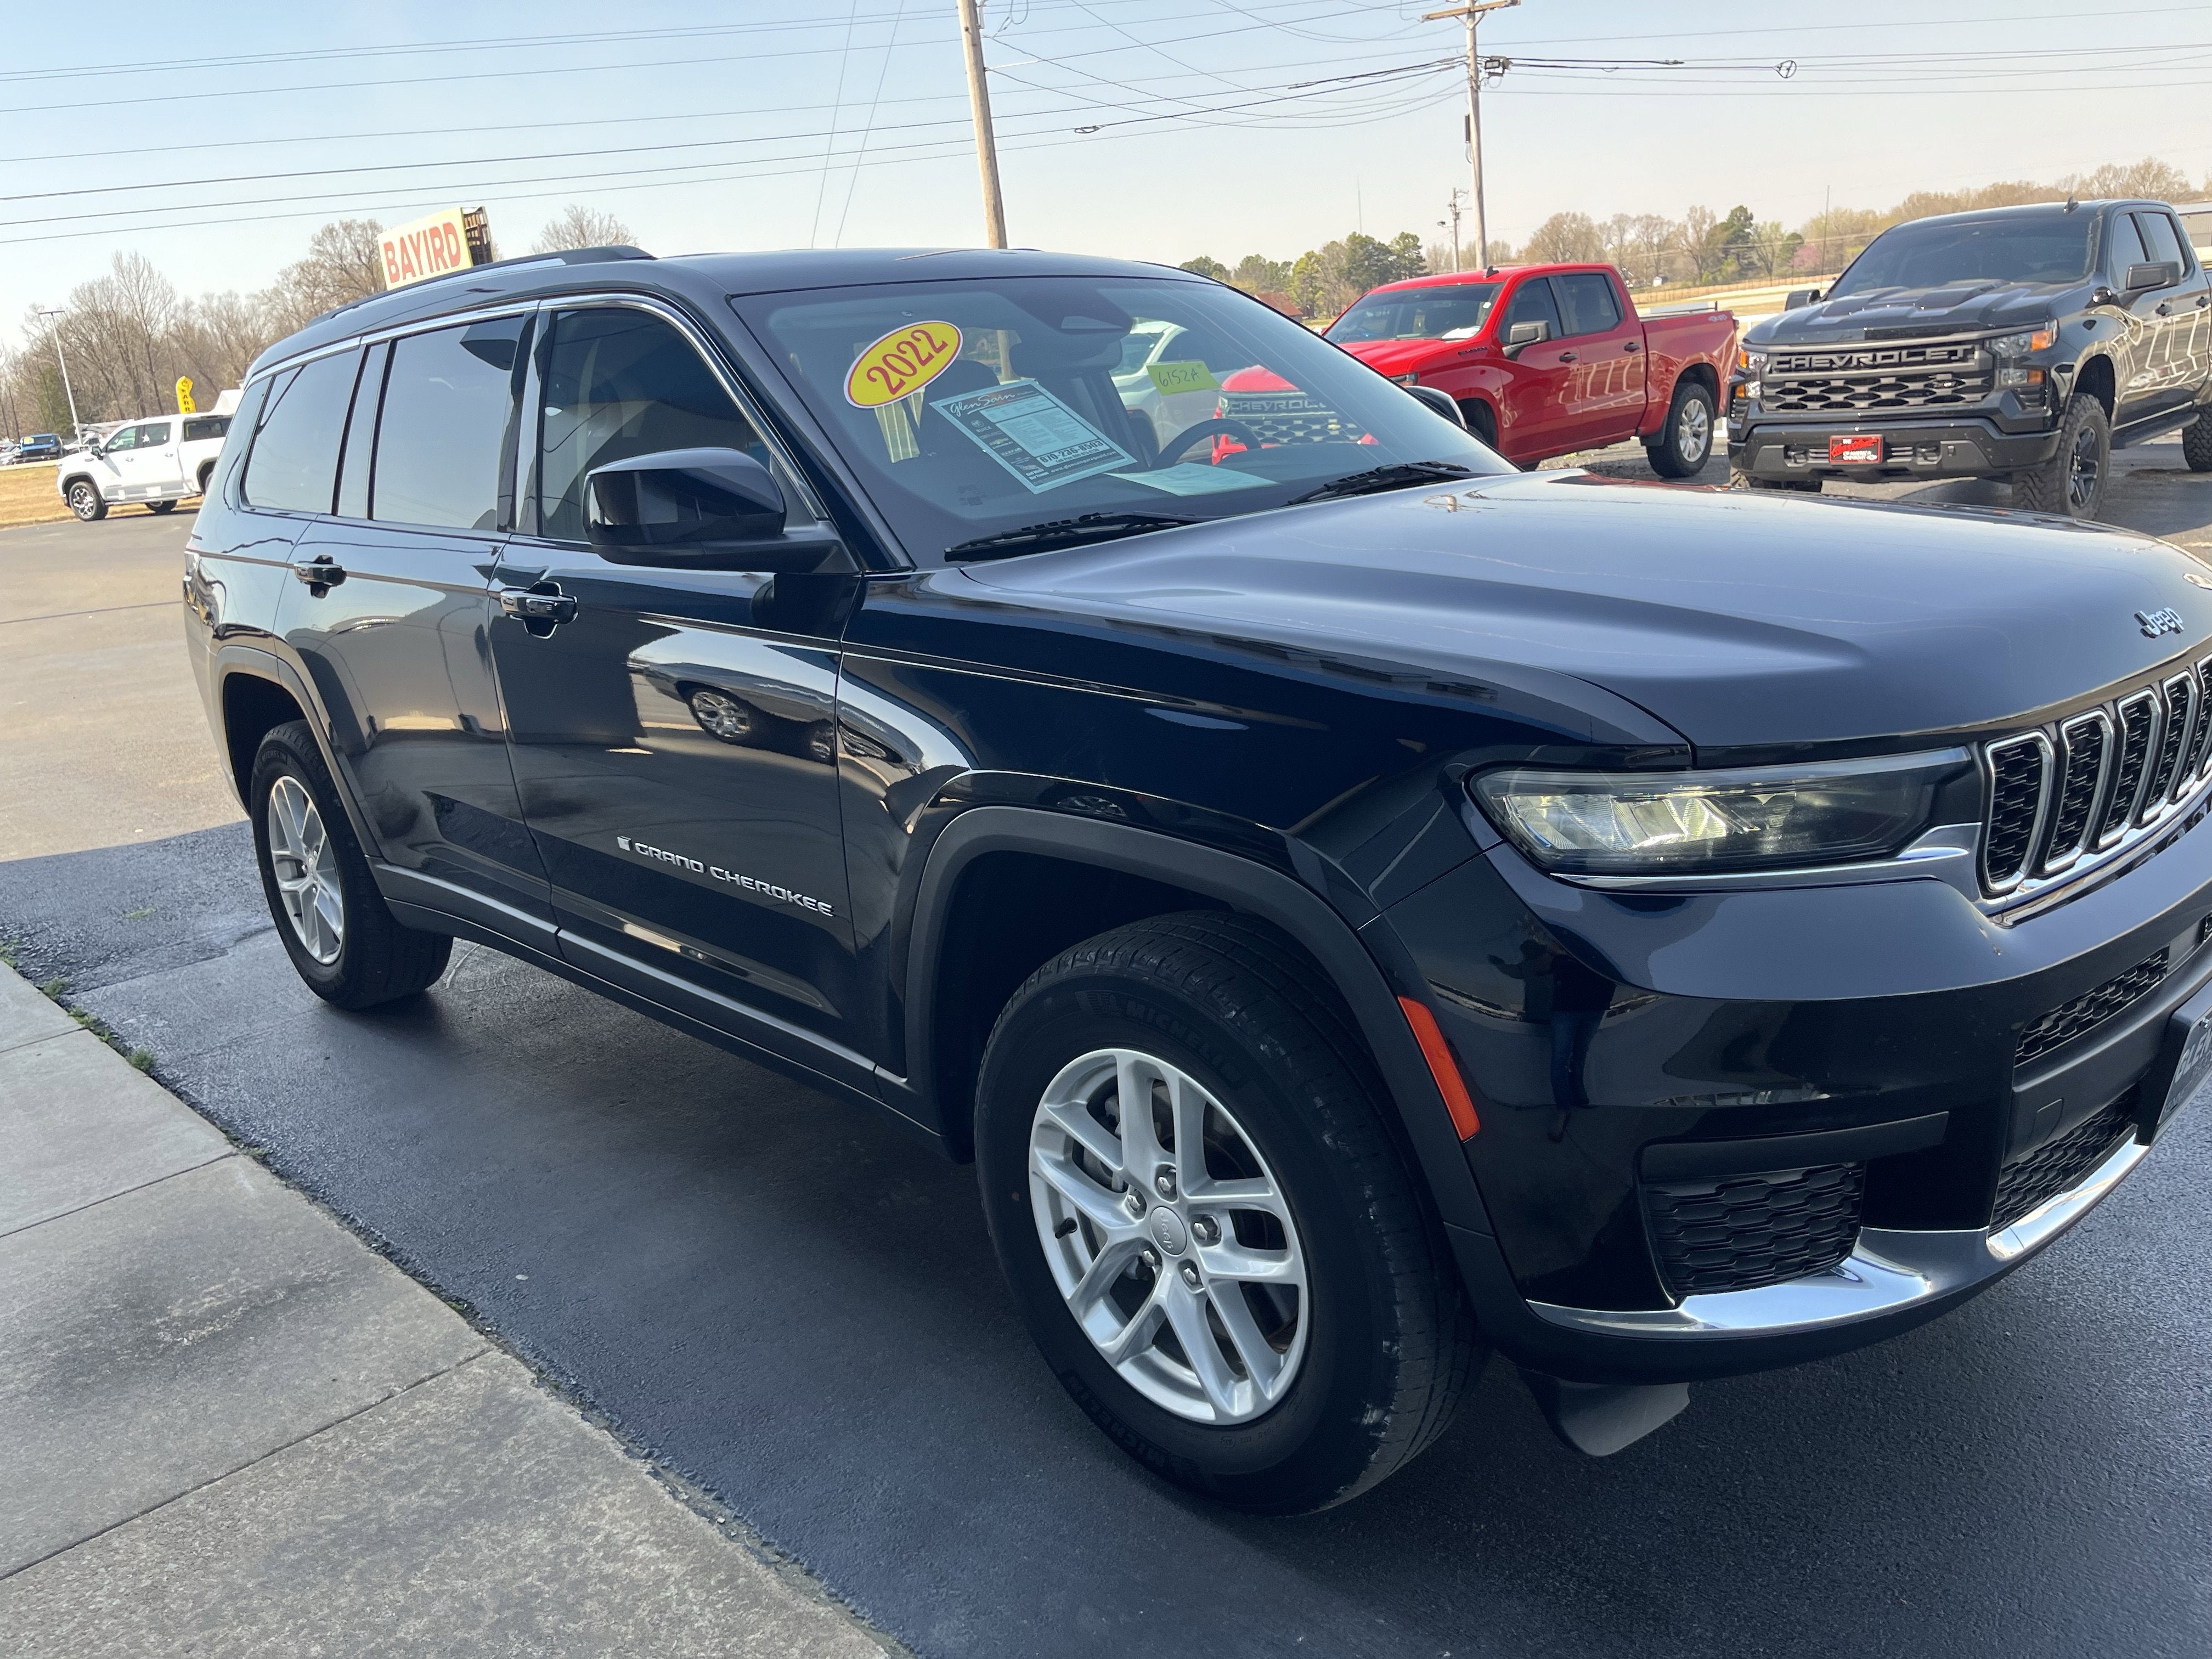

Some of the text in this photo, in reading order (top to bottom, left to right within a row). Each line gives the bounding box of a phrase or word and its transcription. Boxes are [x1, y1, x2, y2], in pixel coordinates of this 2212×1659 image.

[383, 222, 461, 284] BAYIRD
[866, 329, 949, 395] 2022
[1773, 345, 1973, 370] CHEVROLET
[1158, 368, 1200, 387] 6152A
[950, 402, 981, 417] Glen
[978, 394, 1015, 407] Sain
[1229, 399, 1326, 411] CHEVROL
[1039, 440, 1104, 463] 870-236-8503
[2135, 607, 2185, 637] Jeep
[634, 842, 835, 917] GRAND CHEROKEE
[1125, 1000, 1243, 1085] MICHELIN
[1159, 1212, 1174, 1249] Jeep
